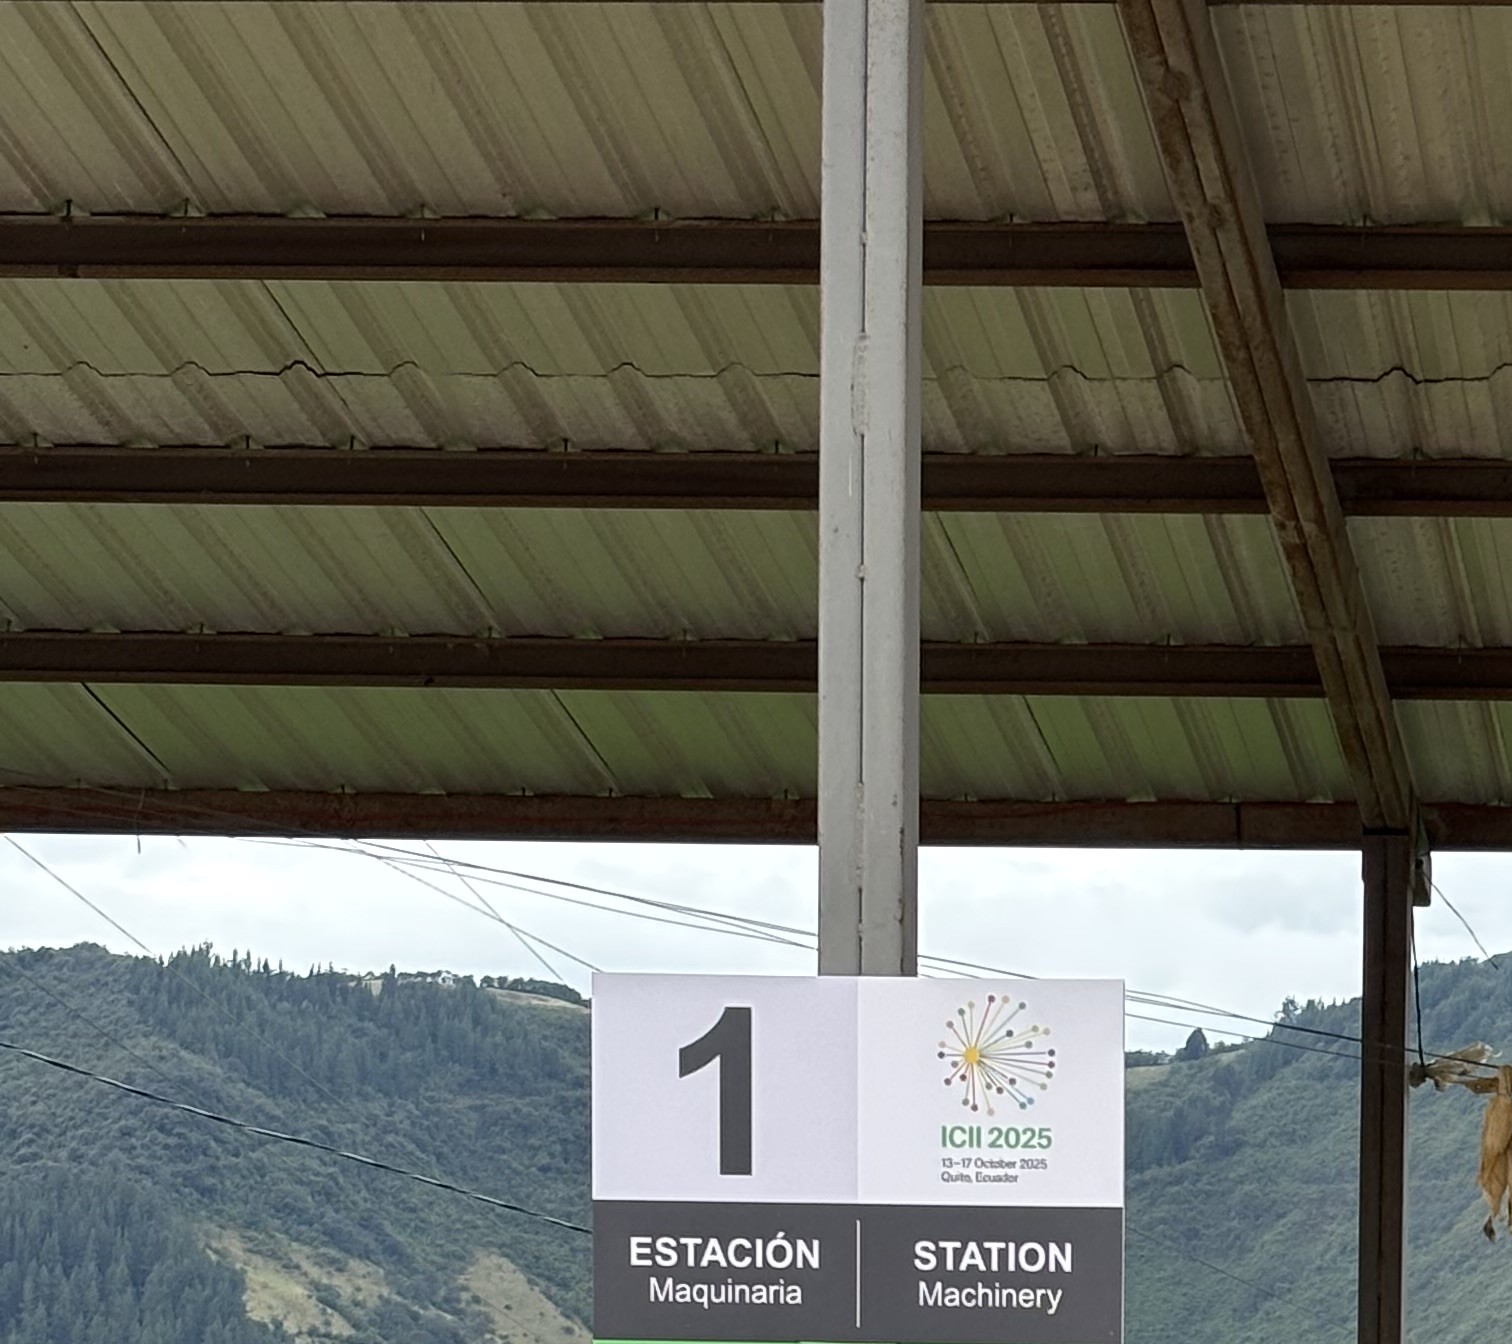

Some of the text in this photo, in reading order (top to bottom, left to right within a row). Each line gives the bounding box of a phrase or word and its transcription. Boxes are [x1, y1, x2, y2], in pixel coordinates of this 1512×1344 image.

[678, 1006, 753, 1176] 1
[941, 1125, 1052, 1150] ICII 2025
[974, 1157, 1017, 1169] October
[1019, 1158, 1048, 1170] 2025
[975, 1171, 1019, 1183] Ecuador
[629, 1231, 820, 1269] ESTACIÓN
[913, 1240, 1073, 1273] STATION
[648, 1276, 802, 1310] Maquinaria
[918, 1280, 1063, 1315] Machinery
